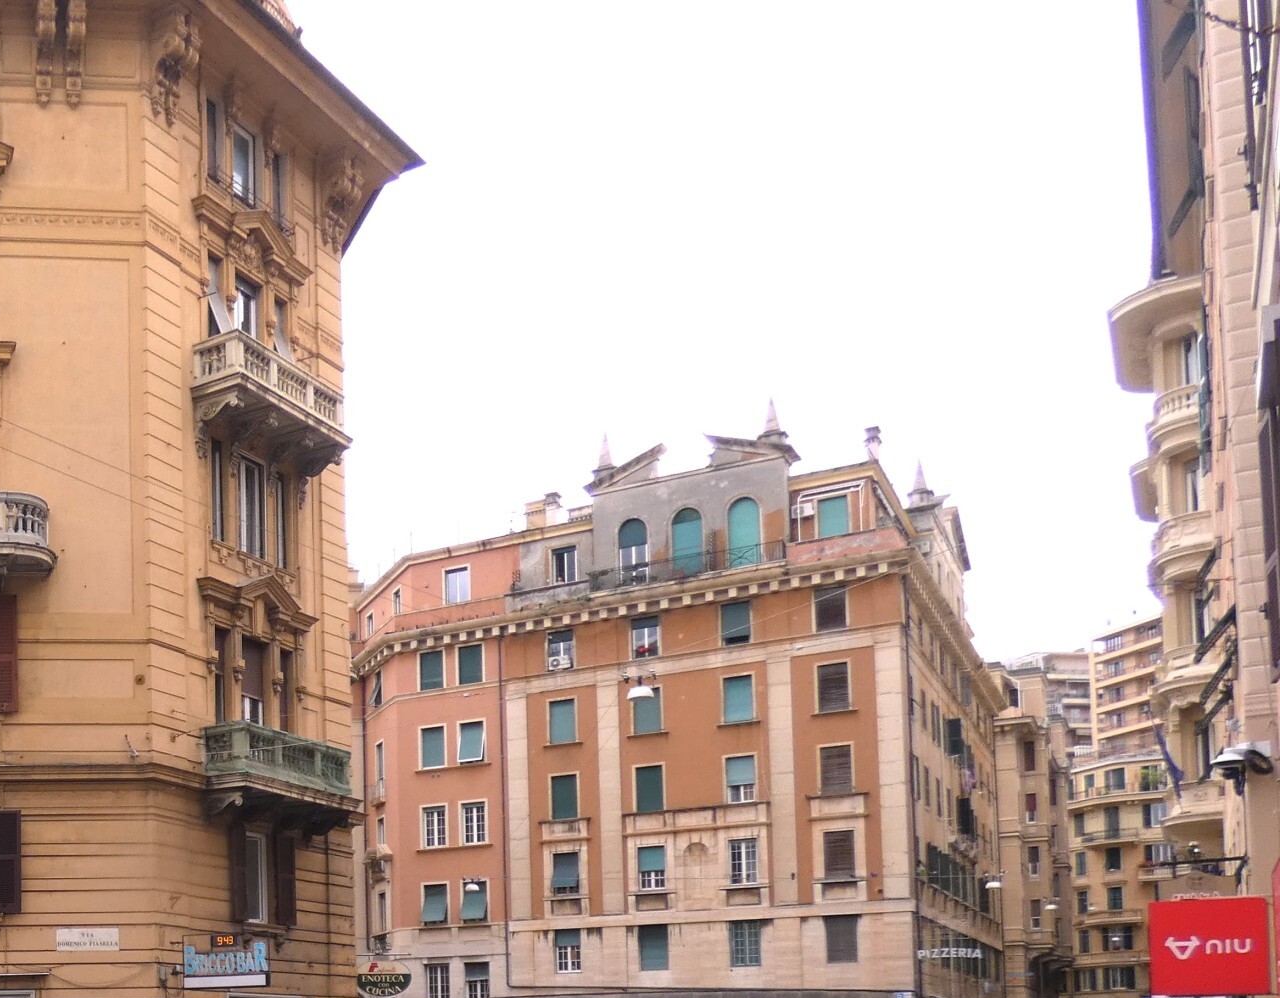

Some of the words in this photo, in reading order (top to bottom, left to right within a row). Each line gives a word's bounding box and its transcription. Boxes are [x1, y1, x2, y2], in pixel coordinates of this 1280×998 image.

[917, 948, 983, 959] PIZZERIA
[362, 974, 405, 983] ENOTECA
[366, 986, 402, 996] CUCINA
